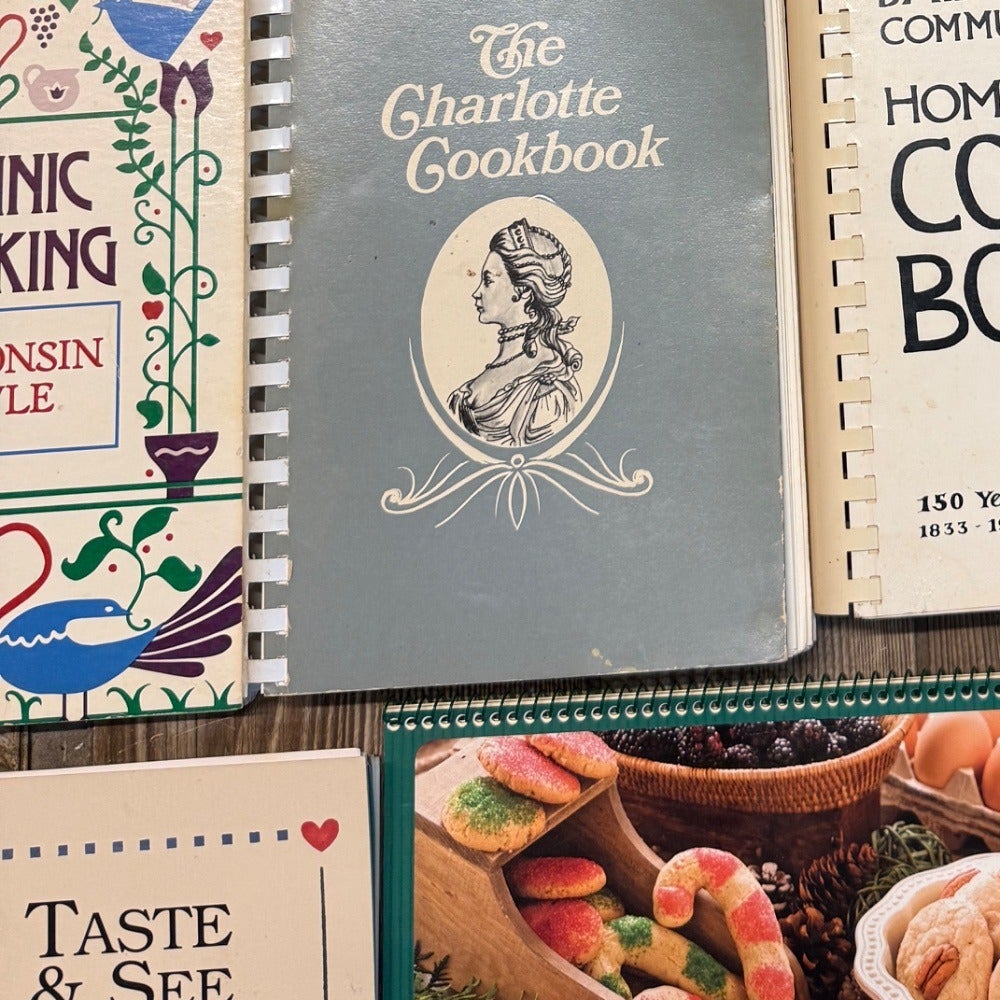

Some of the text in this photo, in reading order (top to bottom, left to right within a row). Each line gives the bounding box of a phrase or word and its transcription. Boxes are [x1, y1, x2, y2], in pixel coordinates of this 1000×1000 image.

[469, 21, 566, 79] The
[381, 77, 622, 140] Charlotte
[0, 150, 92, 216] NIC
[406, 124, 669, 194] Cookbook
[0, 337, 104, 374] NSIN
[0, 382, 55, 415] LE
[917, 491, 964, 514] 150
[919, 520, 969, 538] 1833
[24, 899, 232, 958] TASTE
